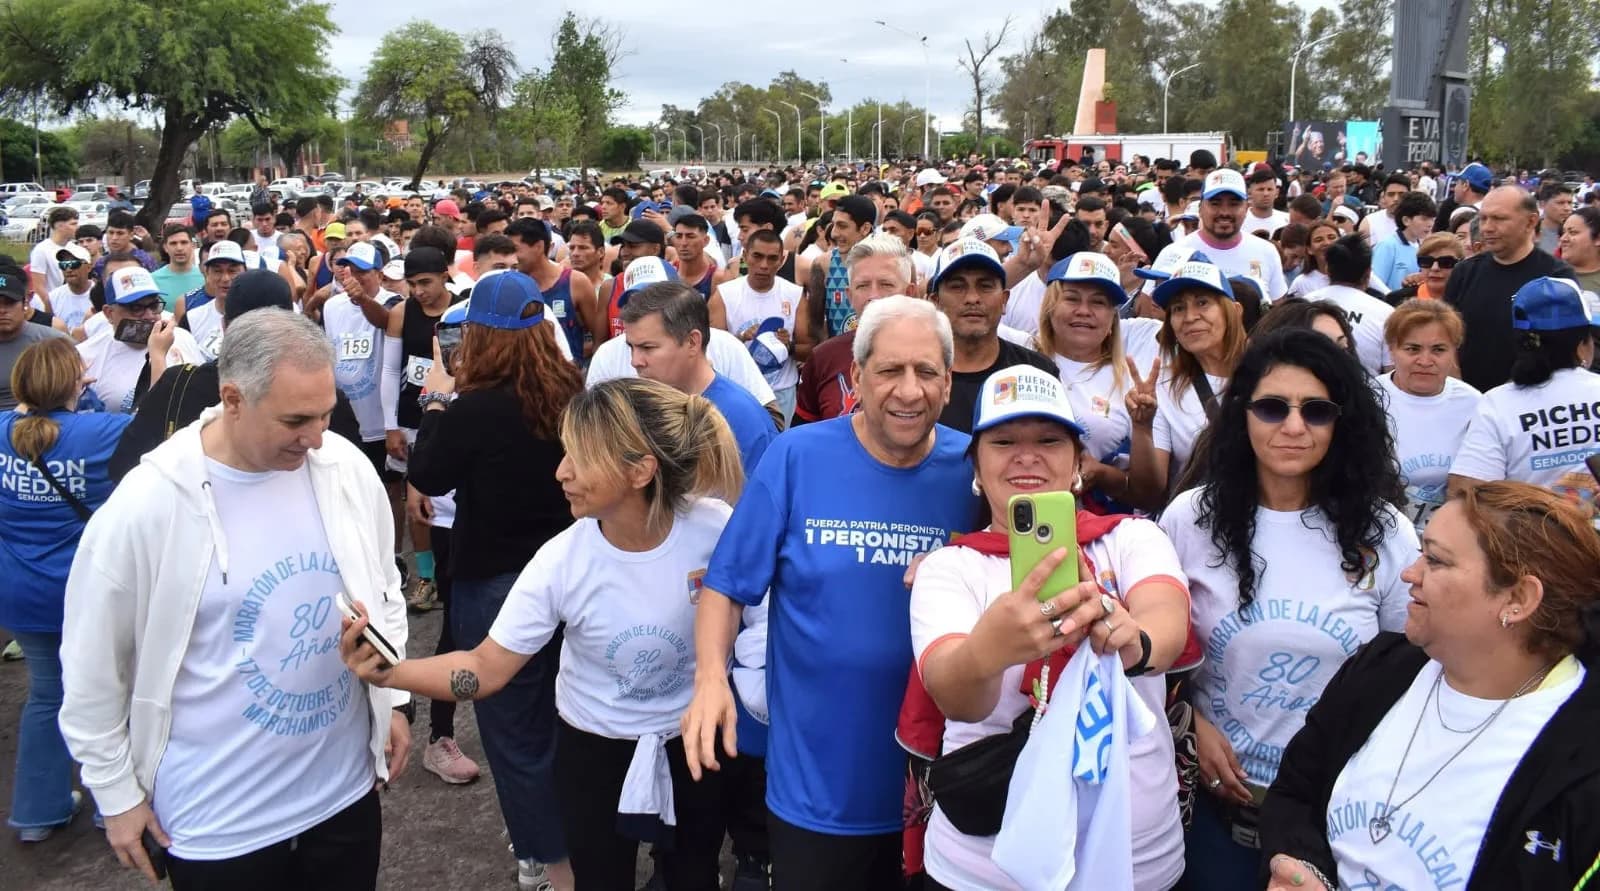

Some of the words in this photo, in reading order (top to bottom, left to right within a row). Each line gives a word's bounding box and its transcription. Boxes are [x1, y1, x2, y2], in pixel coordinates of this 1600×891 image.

[1409, 118, 1440, 139] EVA
[343, 339, 370, 355] 159
[1018, 375, 1057, 392] FUERZA
[1018, 384, 1057, 399] PATRIA
[806, 518, 848, 528] FUERZA
[850, 520, 888, 531] PATRIA
[891, 523, 946, 537] PERONISTA
[805, 529, 814, 544] 1
[820, 529, 945, 552] PERONISTA
[856, 547, 865, 563] 1
[871, 548, 916, 567] AMI
[234, 573, 280, 642] MARATÓN
[275, 557, 299, 579] DE
[299, 551, 320, 573] LA
[290, 596, 332, 640] 80
[1268, 599, 1293, 620] DE
[1296, 601, 1320, 627] LA
[1320, 611, 1362, 656] LEAL
[633, 625, 645, 637] DE
[646, 625, 657, 637] LA
[279, 631, 340, 672] Años
[633, 648, 661, 665] 80
[236, 658, 261, 675] 17
[1259, 651, 1321, 686] 80
[246, 672, 273, 698] DE
[267, 685, 334, 713] OCTUBRE
[242, 703, 338, 737] MARCHAMOS
[1210, 699, 1227, 719] DE
[1223, 719, 1287, 764] OCTUBR
[1396, 812, 1425, 848] LA
